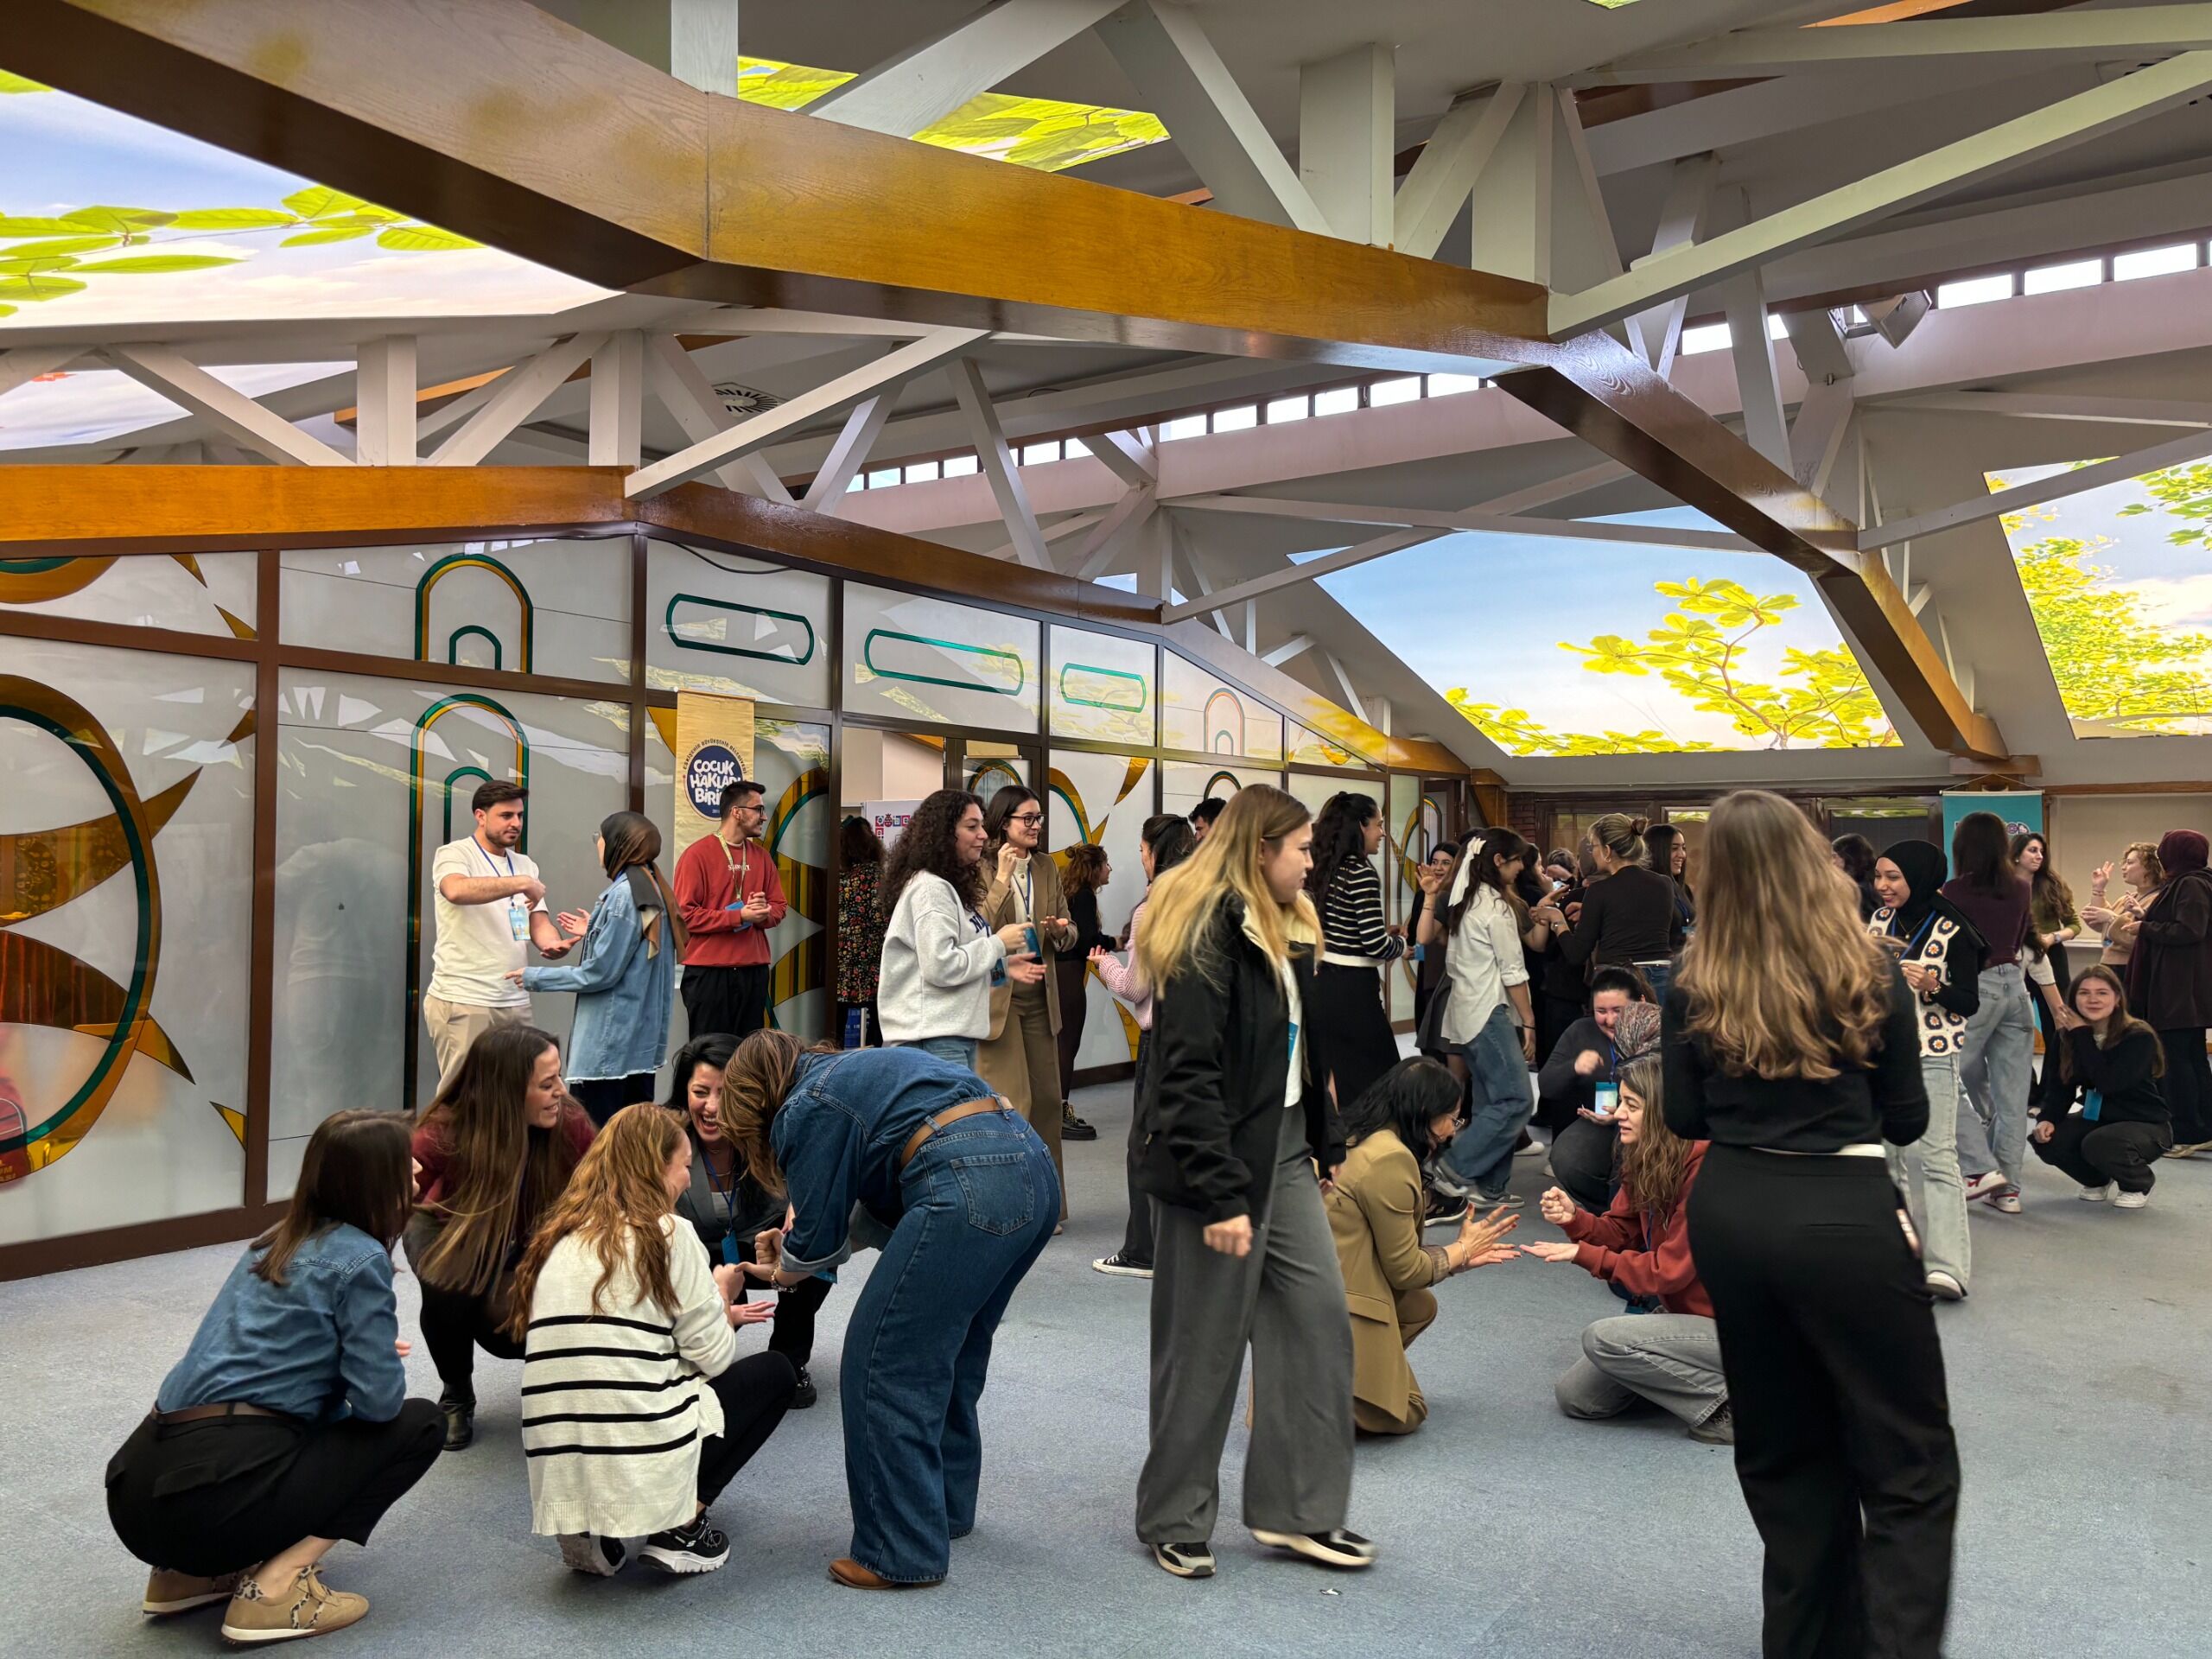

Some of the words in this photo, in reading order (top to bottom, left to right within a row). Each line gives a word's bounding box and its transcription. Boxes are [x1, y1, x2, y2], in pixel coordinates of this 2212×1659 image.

[694, 760, 734, 777] ÇOCUK
[690, 772, 741, 789] HAKLA
[695, 787, 722, 805] BİRİ
